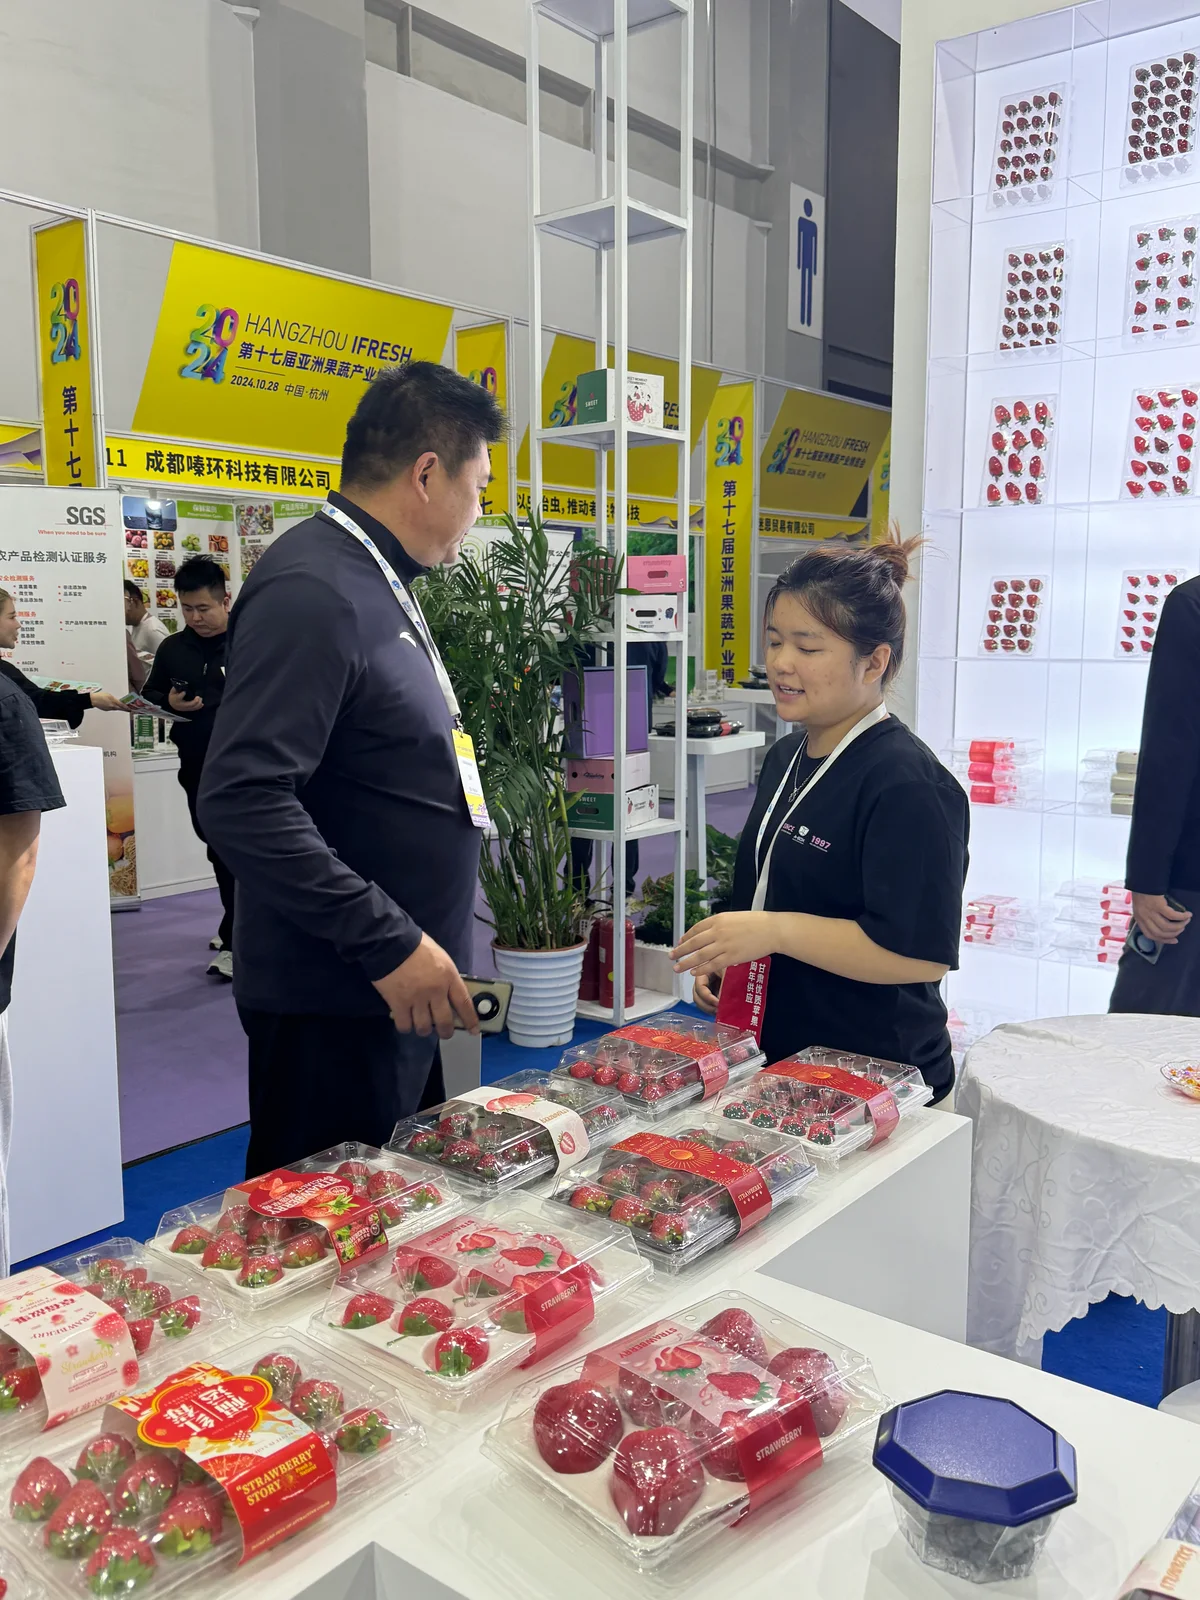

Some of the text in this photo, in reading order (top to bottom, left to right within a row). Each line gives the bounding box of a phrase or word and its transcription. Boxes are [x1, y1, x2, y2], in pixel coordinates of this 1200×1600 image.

[244, 312, 413, 364] HANGZHOU IFRESH
[237, 341, 382, 383] 第十七届亚洲果蔬产业
[230, 374, 279, 393] 2024.10.28
[61, 385, 83, 487] 第十七
[800, 429, 871, 453] HANGZHOU IFRESH
[66, 506, 106, 526] SGS
[0, 549, 107, 564] 农产品检测认证服务
[720, 479, 738, 685] 第十七届亚洲果蔬产业博
[810, 835, 831, 850] 1997
[737, 1183, 764, 1201] STRAWBERRY
[426, 1219, 476, 1247] STRAWBERRY
[540, 1283, 579, 1312] STRAWBERRY
[32, 1310, 97, 1340] STRAWBERRY
[619, 1326, 678, 1359] STRAWBERRY
[755, 1425, 803, 1462] STRAWBERRY
[246, 1483, 283, 1506] STORY
